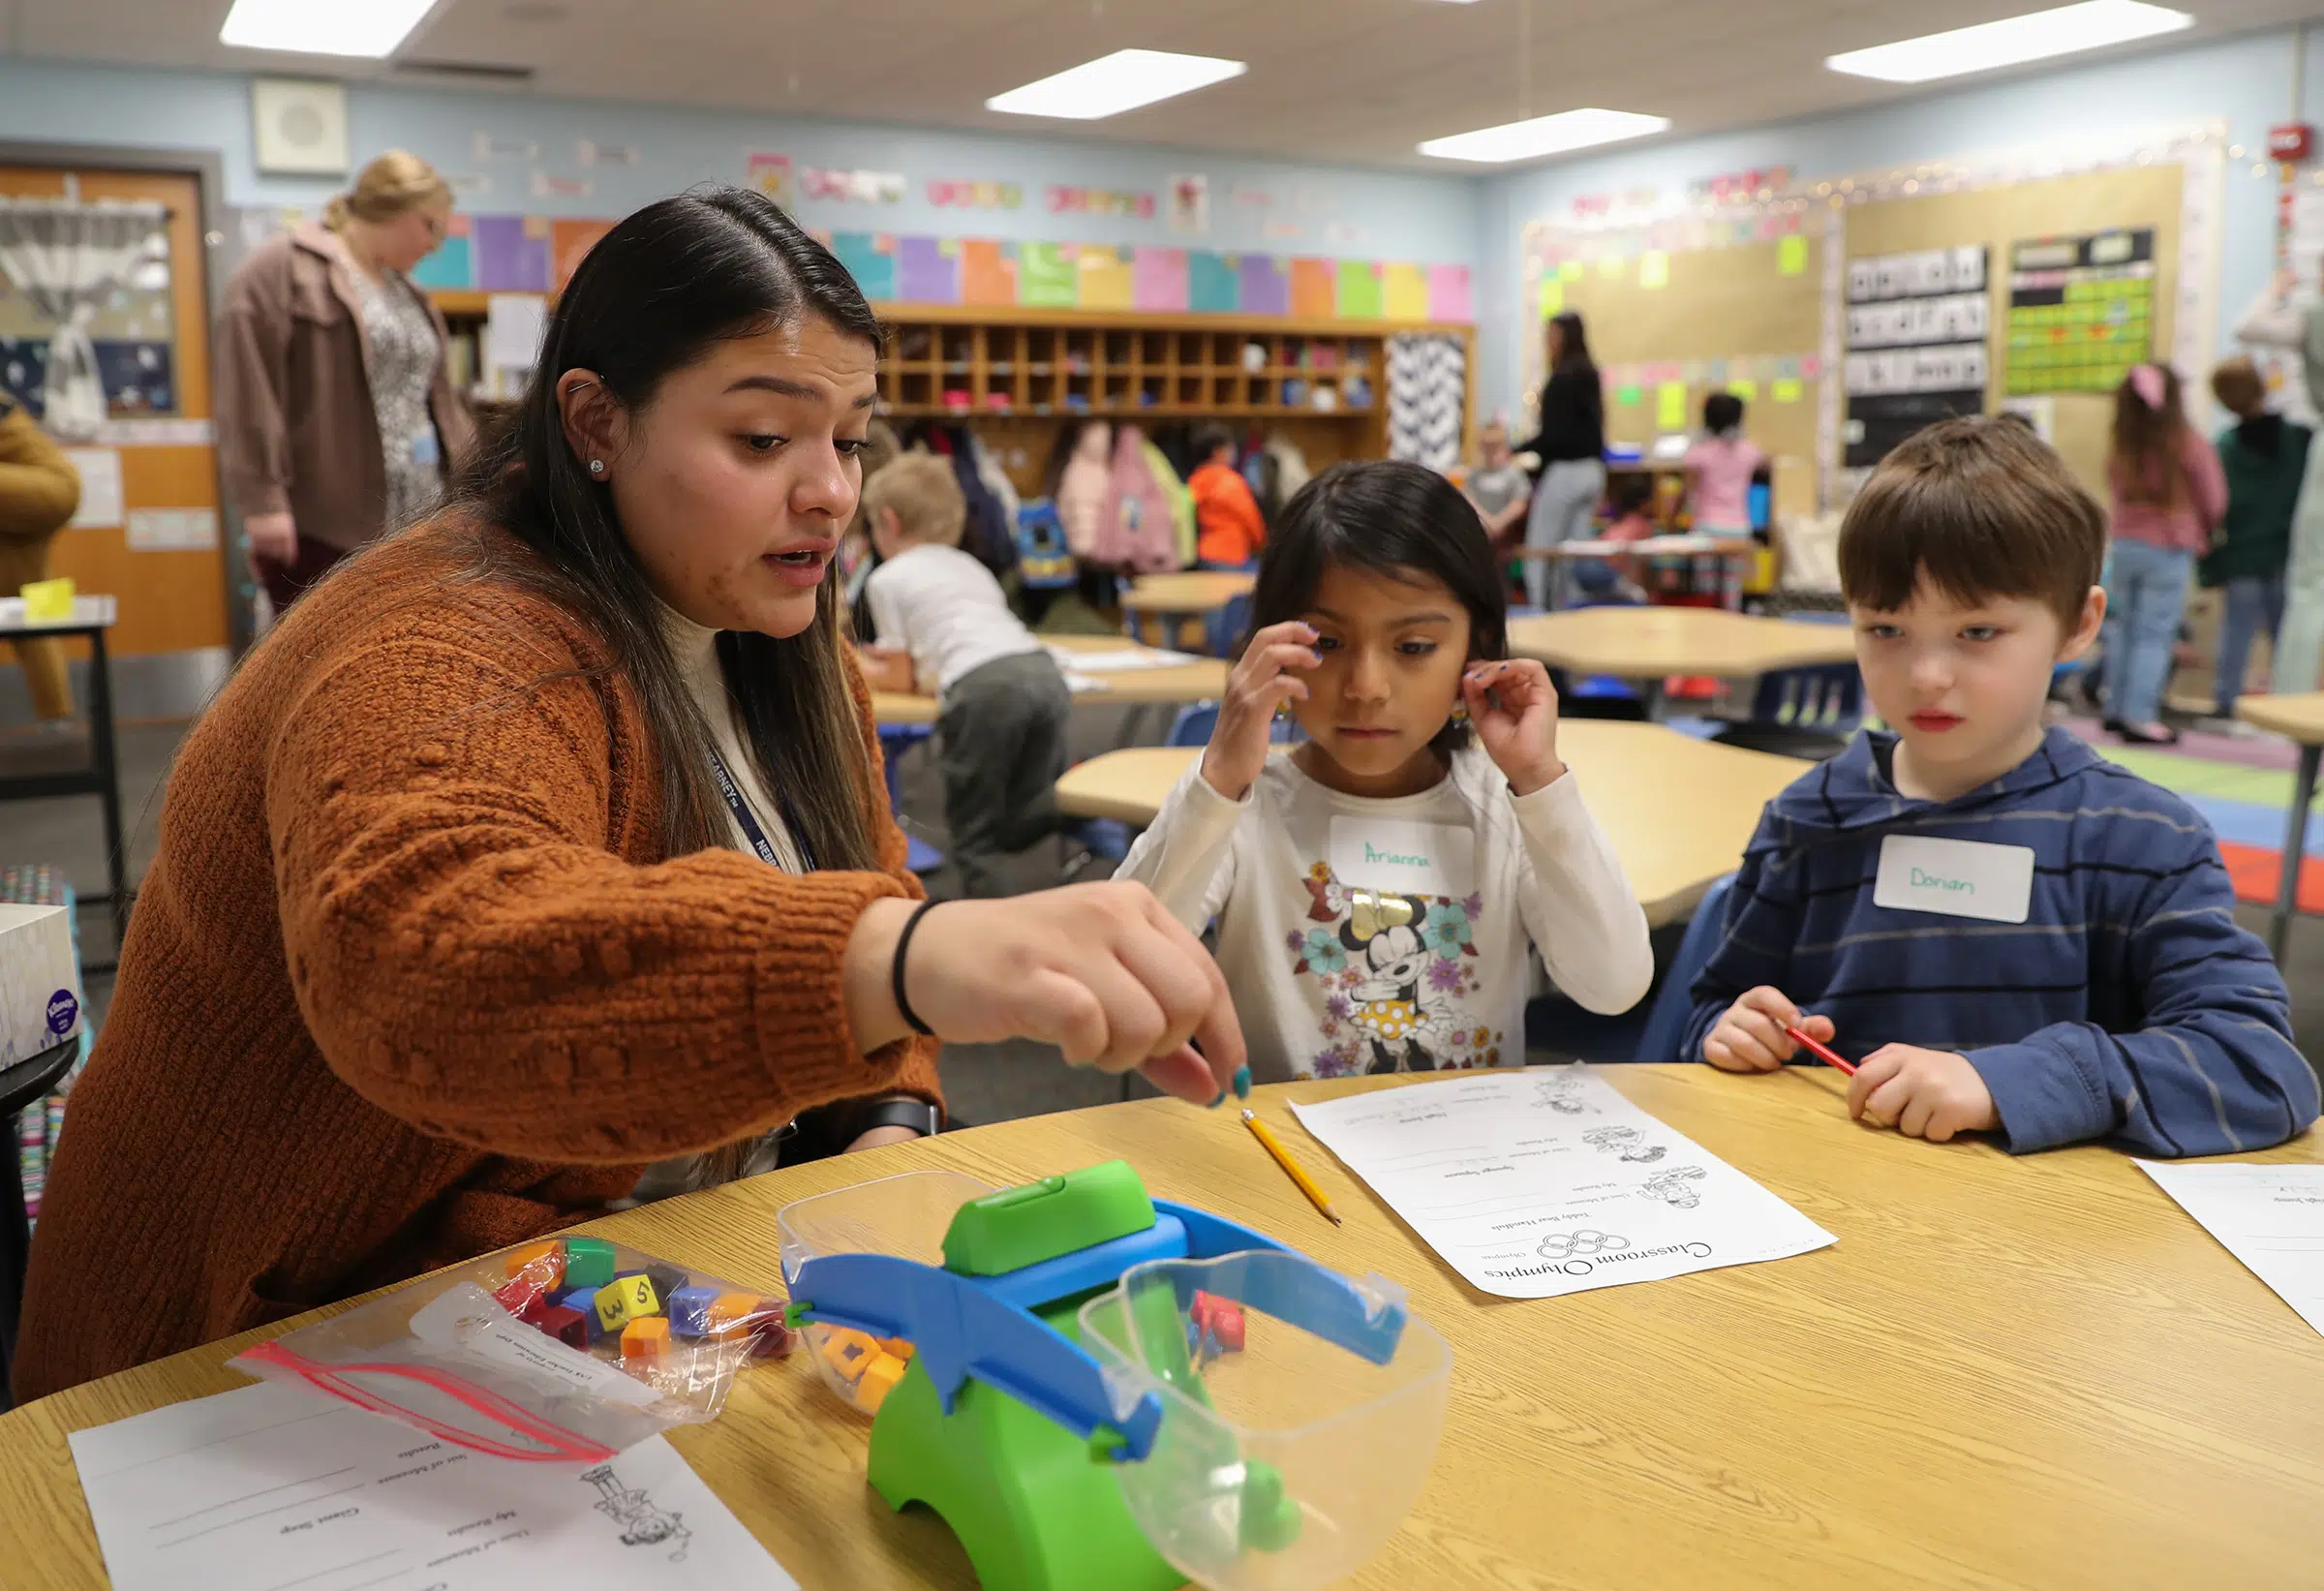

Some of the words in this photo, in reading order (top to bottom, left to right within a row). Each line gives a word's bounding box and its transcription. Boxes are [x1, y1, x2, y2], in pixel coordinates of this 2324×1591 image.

[1364, 841, 1431, 868] Arianna
[1490, 1219, 1538, 1232] Handfuls
[1539, 1216, 1561, 1226] Bear
[1561, 1211, 1593, 1222] Teddy
[1481, 1251, 1527, 1261] Olympian
[1595, 1242, 1712, 1267] Classroom
[1483, 1260, 1594, 1281] Olympics
[636, 1281, 650, 1304] 5
[602, 1299, 624, 1320] 3
[376, 1465, 429, 1485] Measure
[317, 1507, 360, 1524] Giant
[279, 1519, 315, 1536] Step
